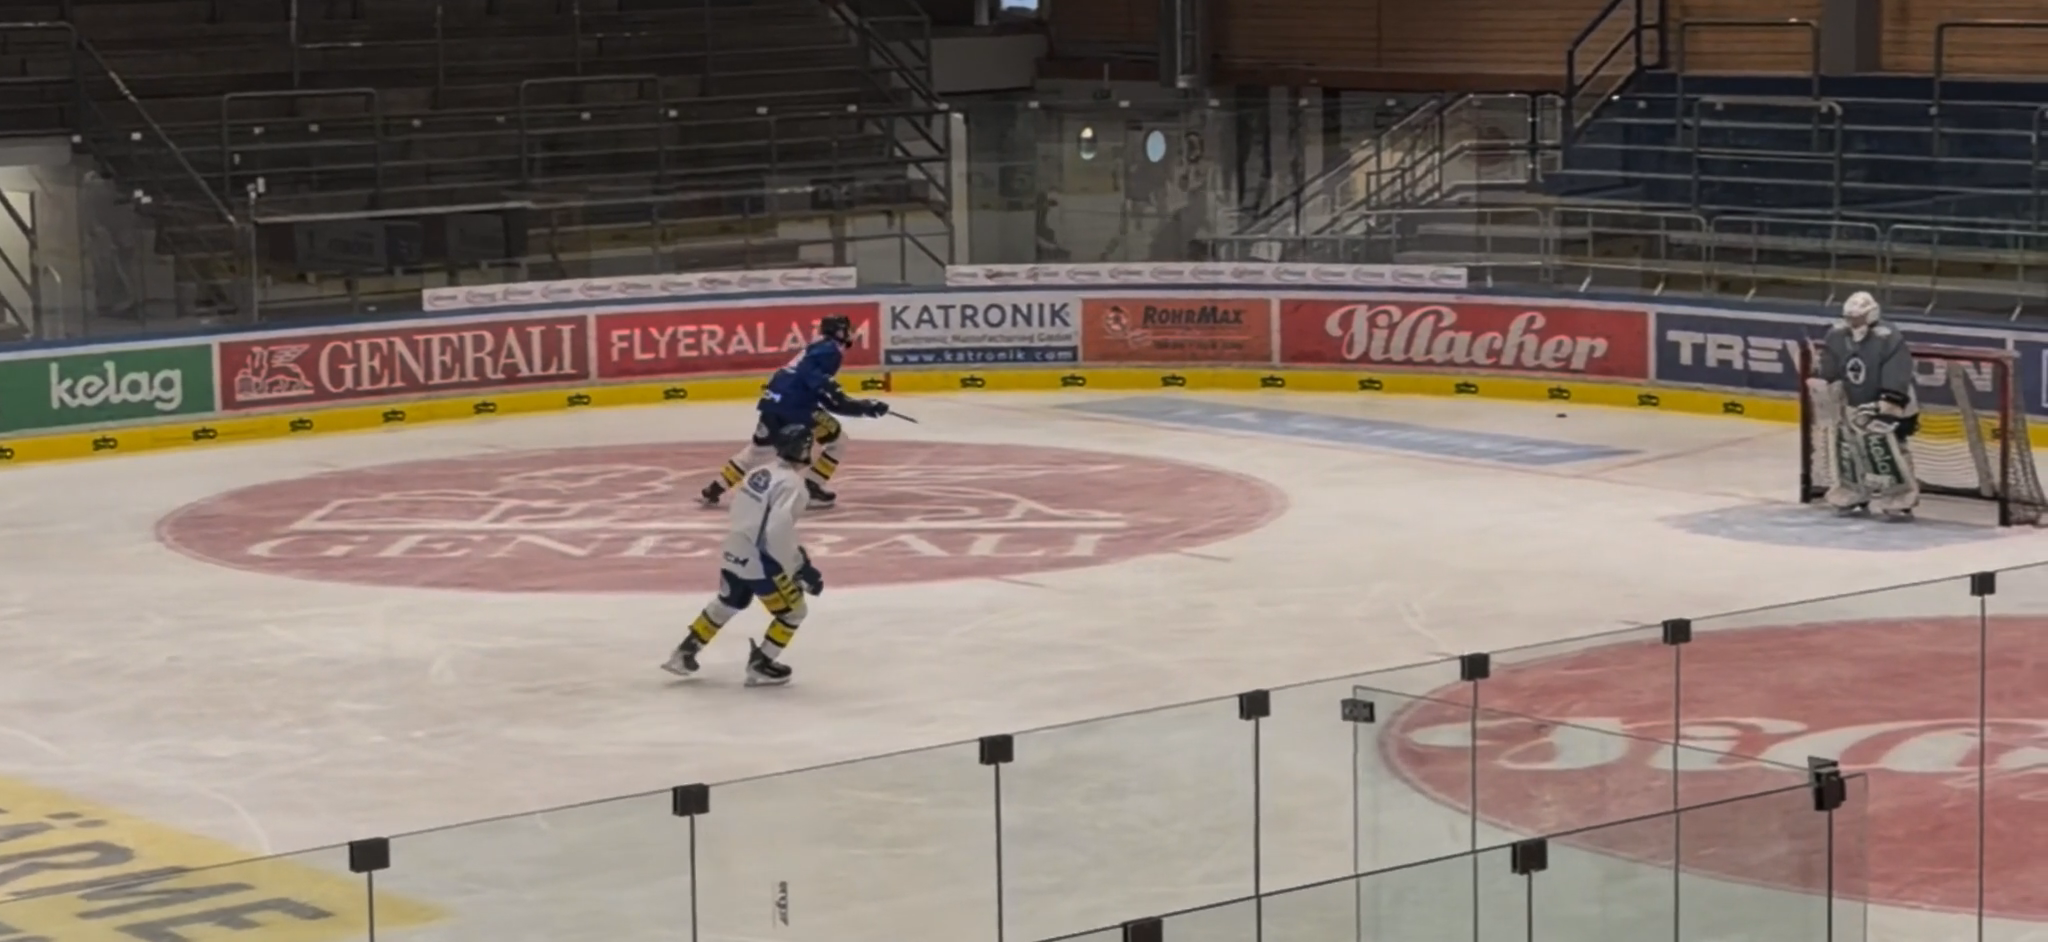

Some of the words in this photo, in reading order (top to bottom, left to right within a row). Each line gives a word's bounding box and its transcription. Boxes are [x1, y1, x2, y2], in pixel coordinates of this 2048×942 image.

[610, 318, 871, 362] FLYERALAM
[890, 303, 1071, 330] KATRONIK
[1325, 304, 1608, 370] Villacher
[318, 324, 577, 393] GENERALI
[889, 349, 1073, 363] www.katronikcom
[1666, 330, 1994, 392] TREON
[50, 361, 182, 410] kelag
